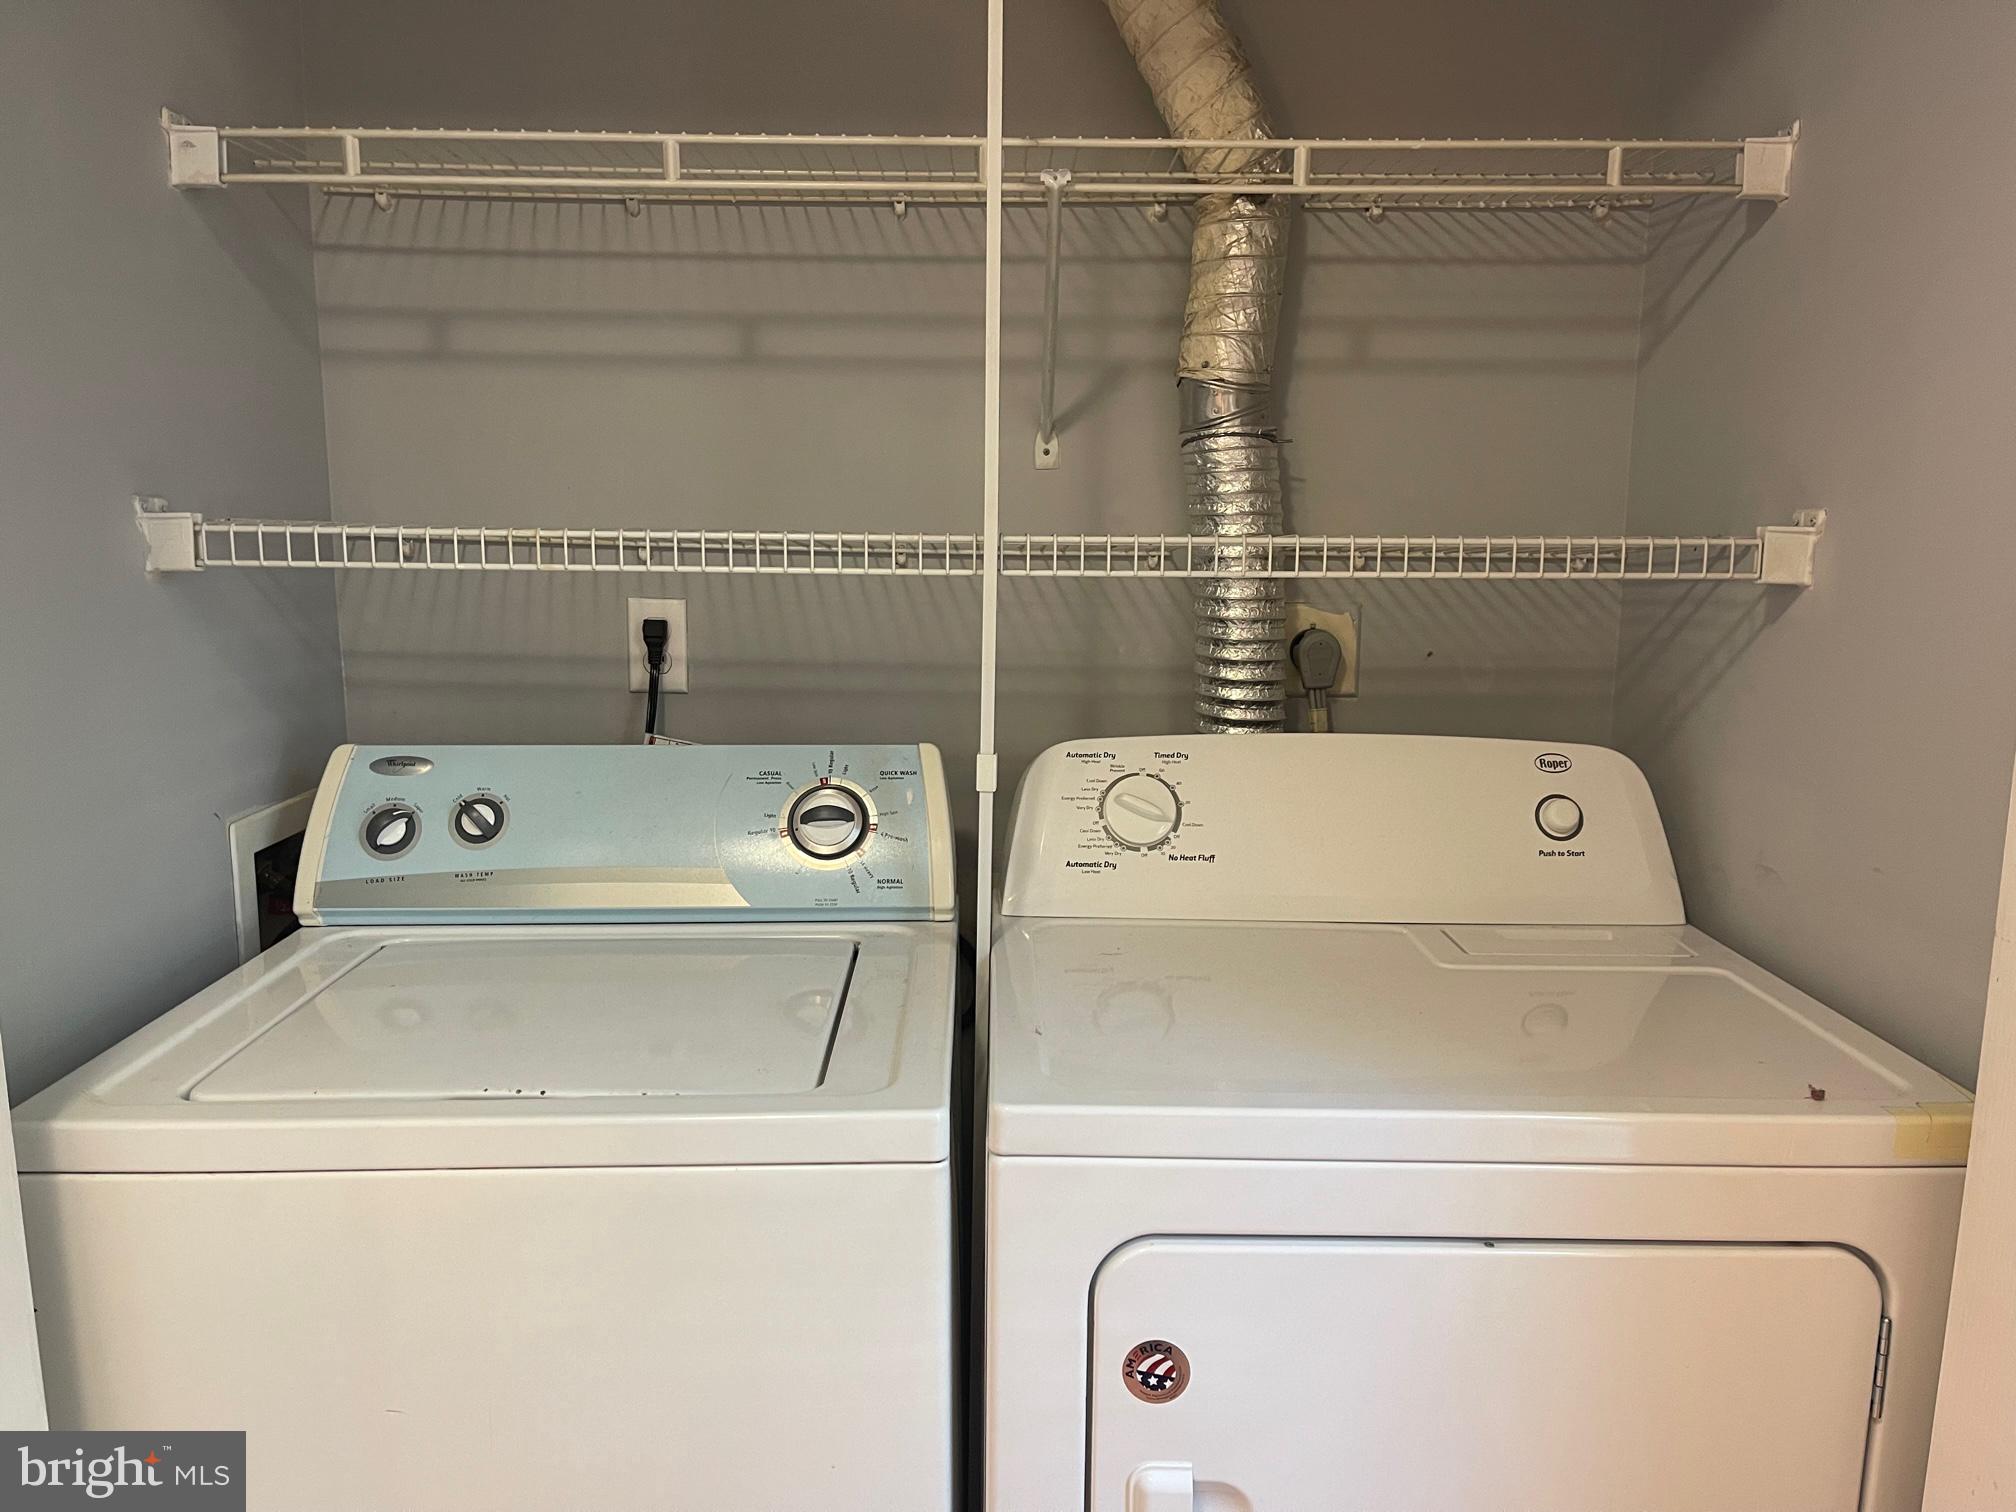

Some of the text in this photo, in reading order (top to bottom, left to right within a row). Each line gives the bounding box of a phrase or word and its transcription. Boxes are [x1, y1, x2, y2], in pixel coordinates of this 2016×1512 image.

[1176, 752, 1188, 760] Dry
[386, 760, 416, 768] Whirlpool
[1538, 758, 1568, 770] Roper
[1198, 854, 1216, 863] Fluff
[1104, 861, 1117, 870] Dry
[1126, 1344, 1173, 1379] AMERICA
